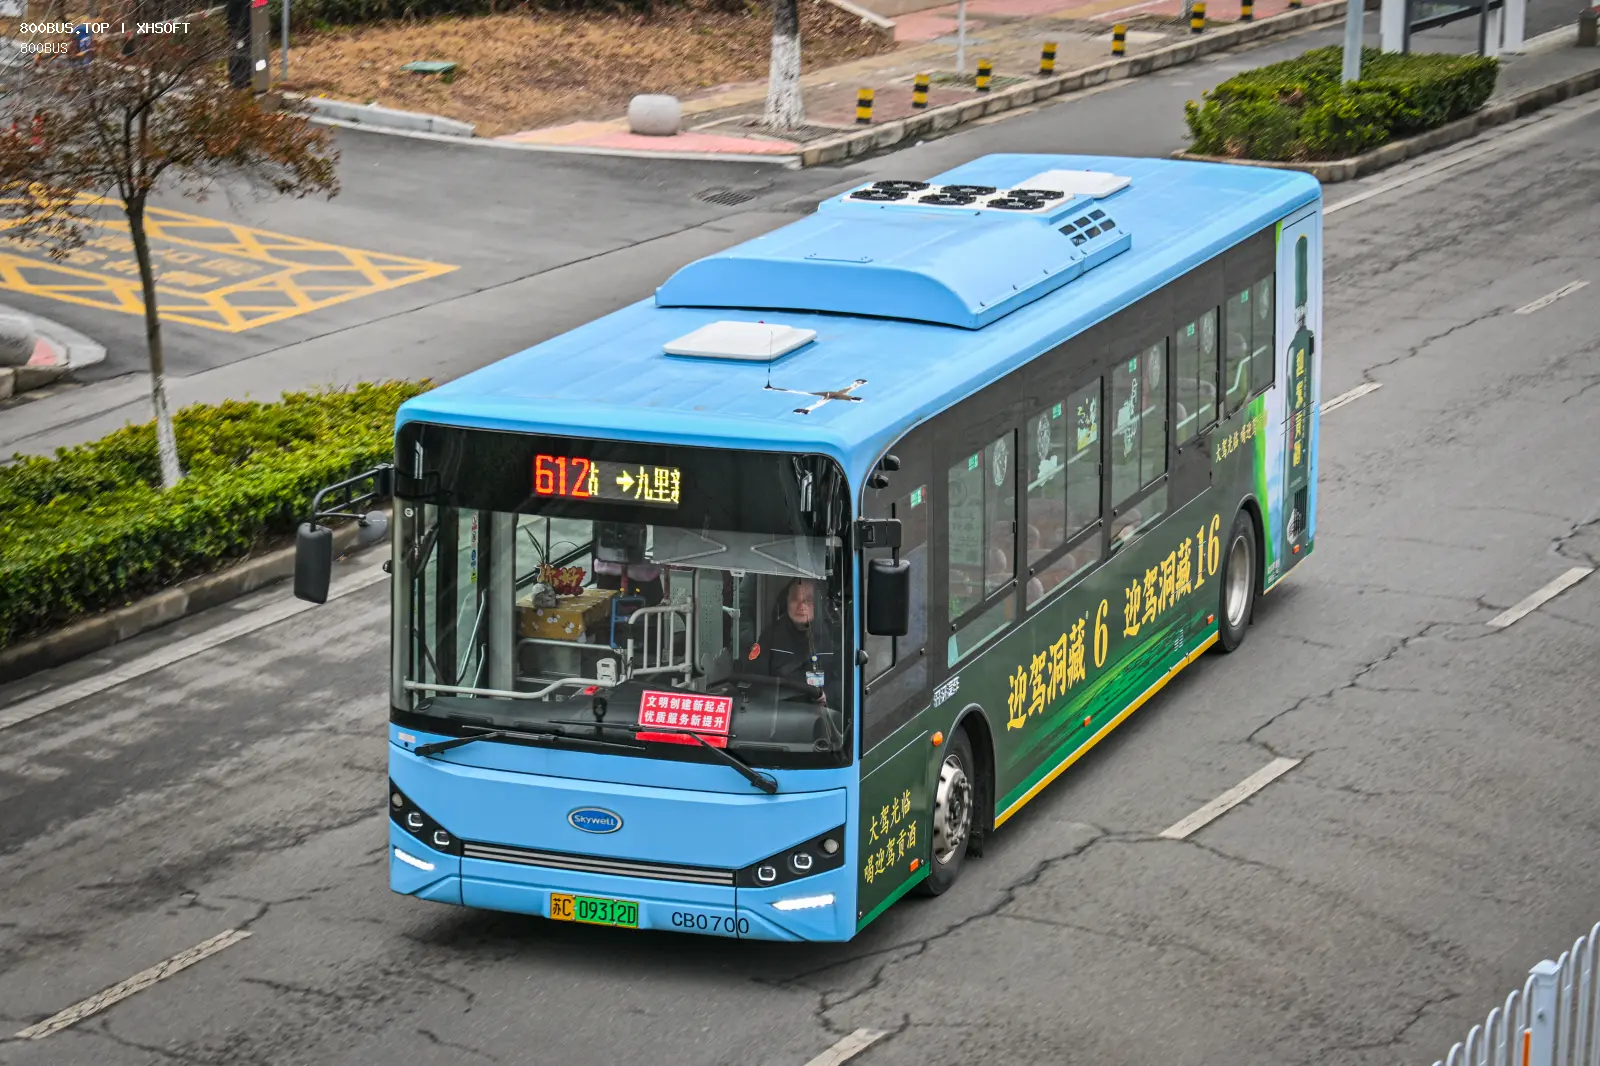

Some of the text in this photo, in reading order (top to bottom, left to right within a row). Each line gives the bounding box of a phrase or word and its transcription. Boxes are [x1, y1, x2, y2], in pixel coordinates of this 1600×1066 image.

[535, 455, 591, 498] 612
[1006, 617, 1087, 731] 迎驾洞藏
[1093, 599, 1109, 668] 6
[644, 710, 724, 729] 优质服务新提升
[646, 695, 727, 714] 文明创建新起点
[574, 814, 616, 826] Skywell
[868, 788, 911, 846] 大驾光临
